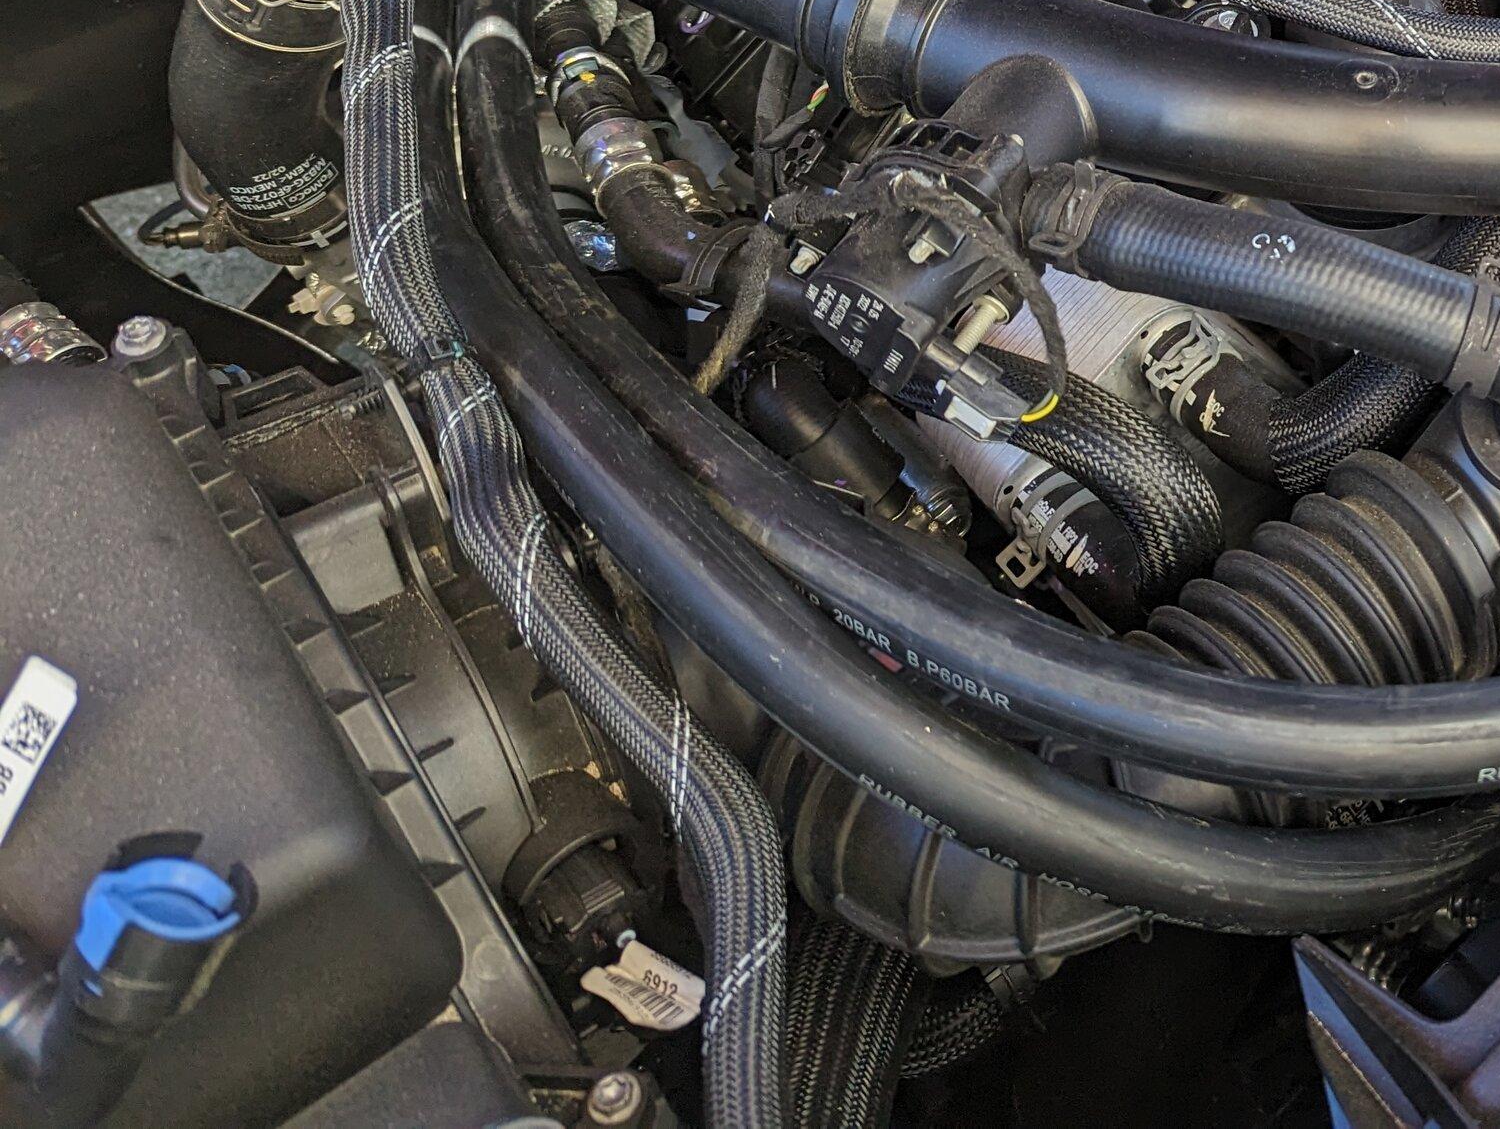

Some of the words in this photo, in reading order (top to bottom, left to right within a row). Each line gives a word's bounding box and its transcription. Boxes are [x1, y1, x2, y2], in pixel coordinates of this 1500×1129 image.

[228, 178, 278, 193] MEXICO
[286, 167, 335, 205] FoMoCo
[830, 607, 894, 654] 20BAR
